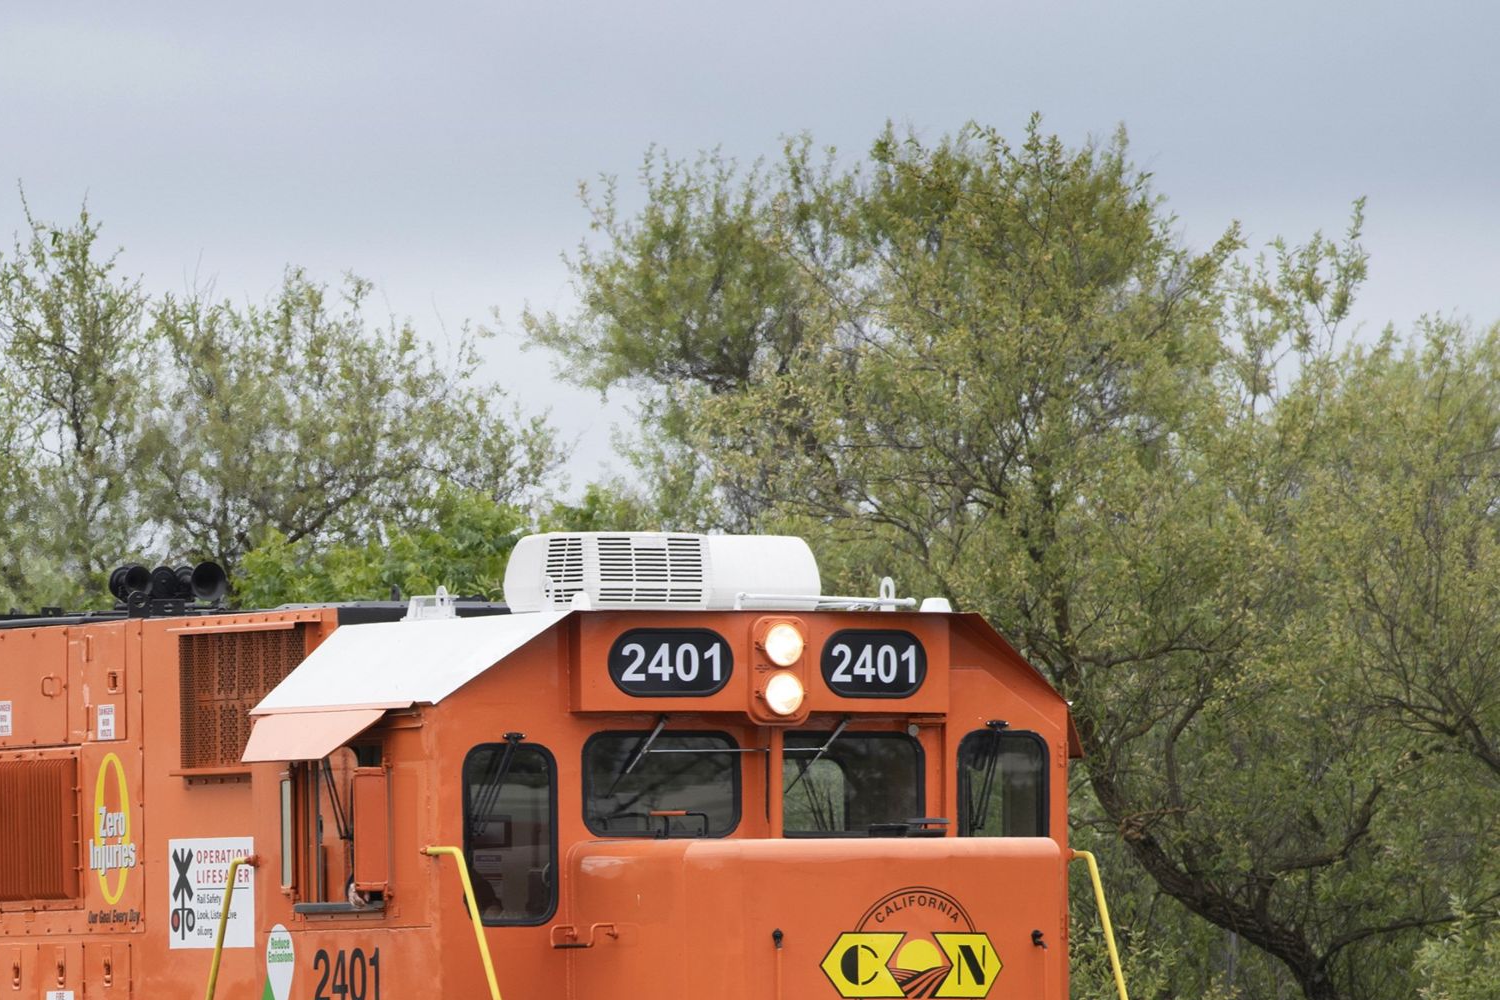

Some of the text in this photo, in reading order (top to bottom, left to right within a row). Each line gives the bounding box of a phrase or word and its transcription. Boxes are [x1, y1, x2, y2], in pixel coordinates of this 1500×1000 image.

[621, 642, 721, 682] 2401
[830, 643, 917, 684] 2401
[98, 806, 126, 838] Zero
[89, 838, 136, 876] Injuries
[196, 869, 250, 884] LIFESAER
[197, 894, 221, 906] Rail Safety
[112, 909, 128, 926] Every
[197, 911, 210, 921] Look,
[875, 895, 960, 924] CALIFORNIA
[197, 926, 213, 938] oli.org
[271, 937, 290, 950] Reduce
[268, 951, 294, 964] Emissions
